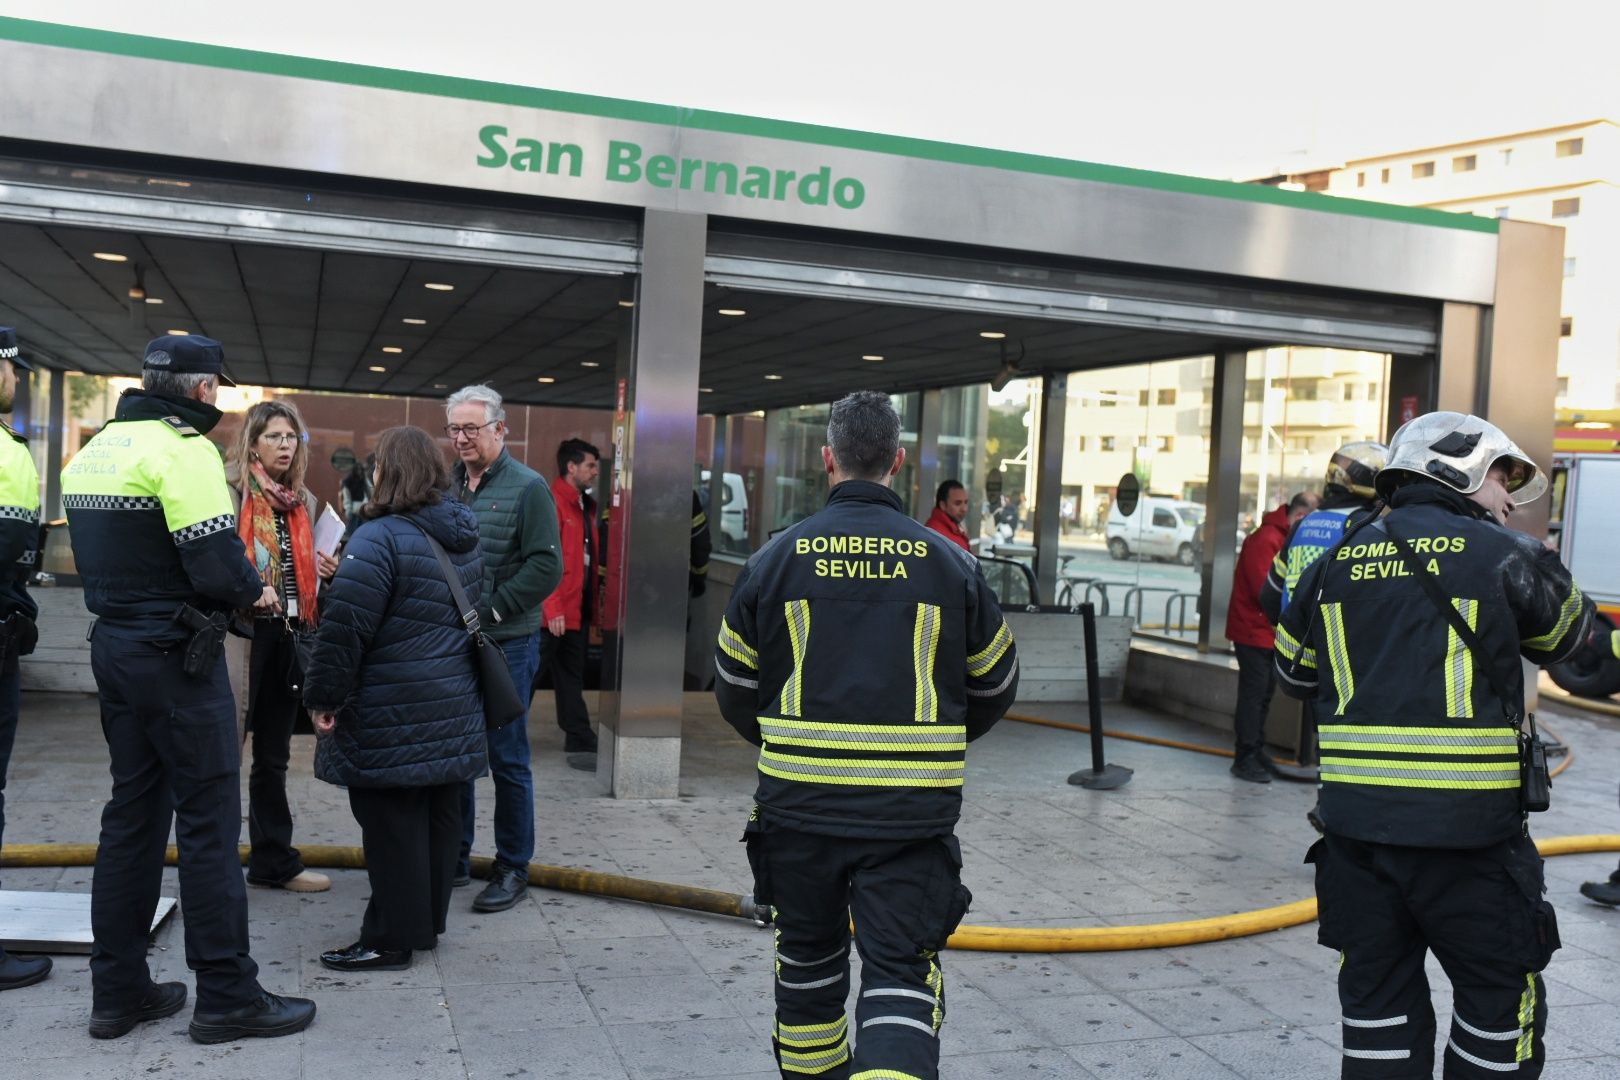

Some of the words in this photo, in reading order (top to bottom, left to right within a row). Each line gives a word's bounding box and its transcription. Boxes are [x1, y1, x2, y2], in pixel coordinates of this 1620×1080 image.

[476, 124, 583, 177] San
[606, 139, 866, 210] Bernardo
[68, 463, 116, 475] SEVILLA
[1301, 528, 1332, 540] SEVILLA
[796, 536, 928, 558] BOMBEROS
[815, 559, 908, 579] SEVILLA
[1349, 557, 1440, 582] SEVILA
